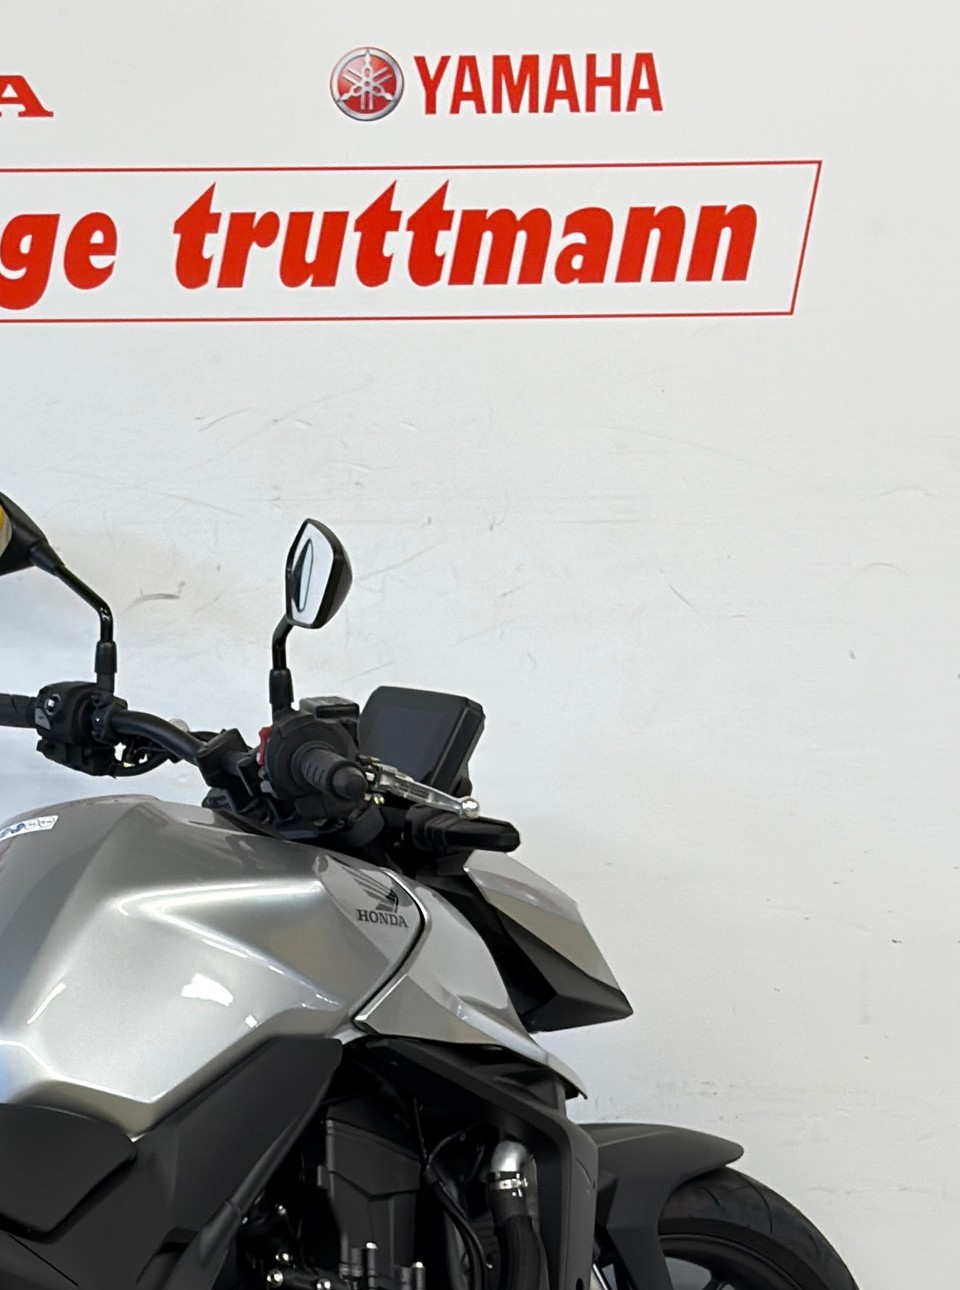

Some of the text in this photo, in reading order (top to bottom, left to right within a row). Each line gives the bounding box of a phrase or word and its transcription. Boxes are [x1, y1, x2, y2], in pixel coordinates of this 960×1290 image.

[414, 53, 664, 115] YAMAHA
[173, 180, 758, 289] truttmann
[355, 908, 408, 928] HONDA
